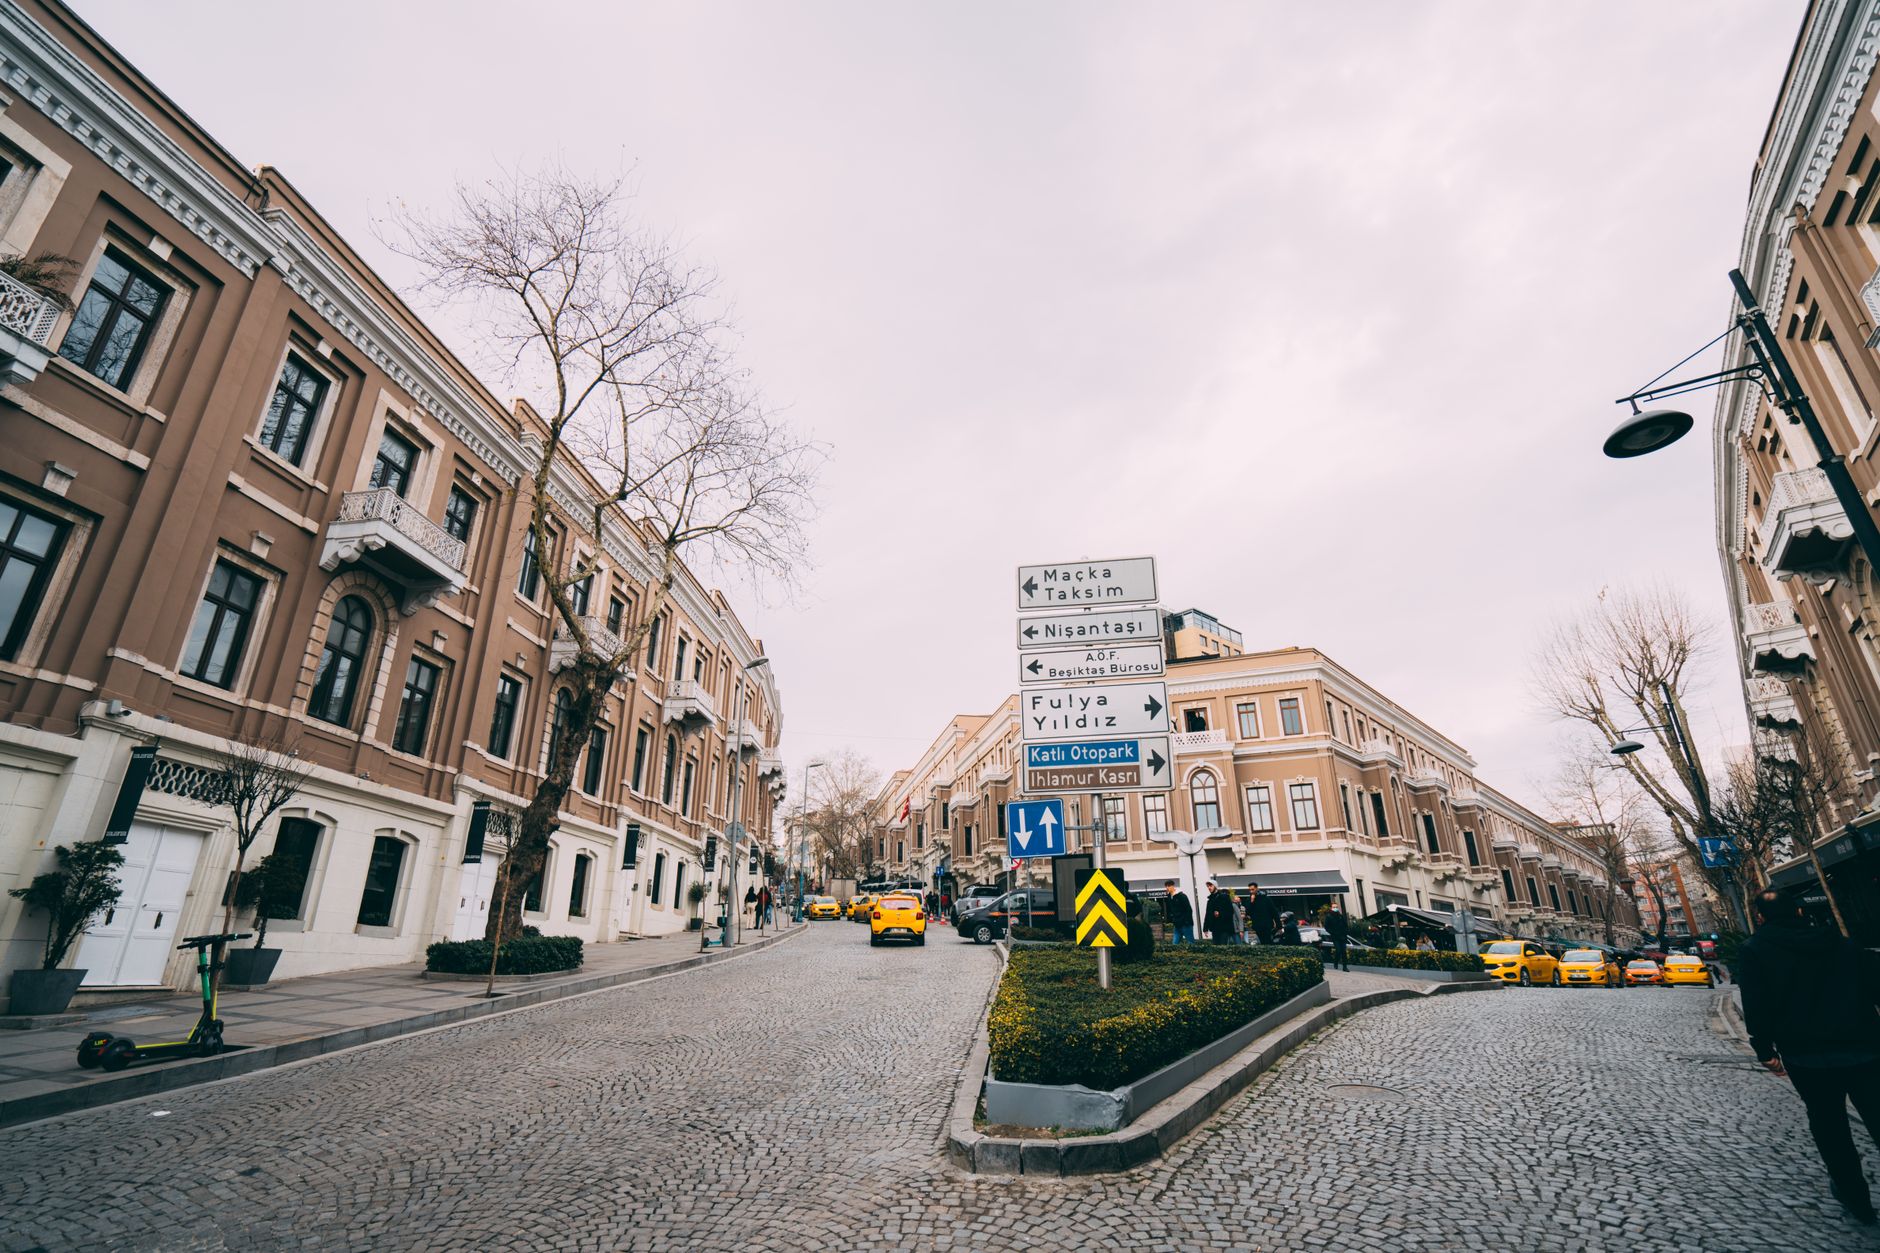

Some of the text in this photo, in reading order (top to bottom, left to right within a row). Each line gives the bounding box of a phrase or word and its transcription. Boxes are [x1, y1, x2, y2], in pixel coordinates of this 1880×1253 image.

[1043, 566, 1112, 583] Maçka
[1044, 585, 1124, 601] Taksim
[1044, 621, 1143, 639] Nişantaşı
[1086, 649, 1120, 662] A.Ö.F.
[1049, 662, 1159, 678] Beşiktaş Bürosu
[1031, 694, 1108, 711] Fulya
[1033, 714, 1117, 731] Yıldız
[1031, 743, 1135, 763] Katlı Otopark
[1031, 768, 1138, 788] Ihlamur Kasrı
